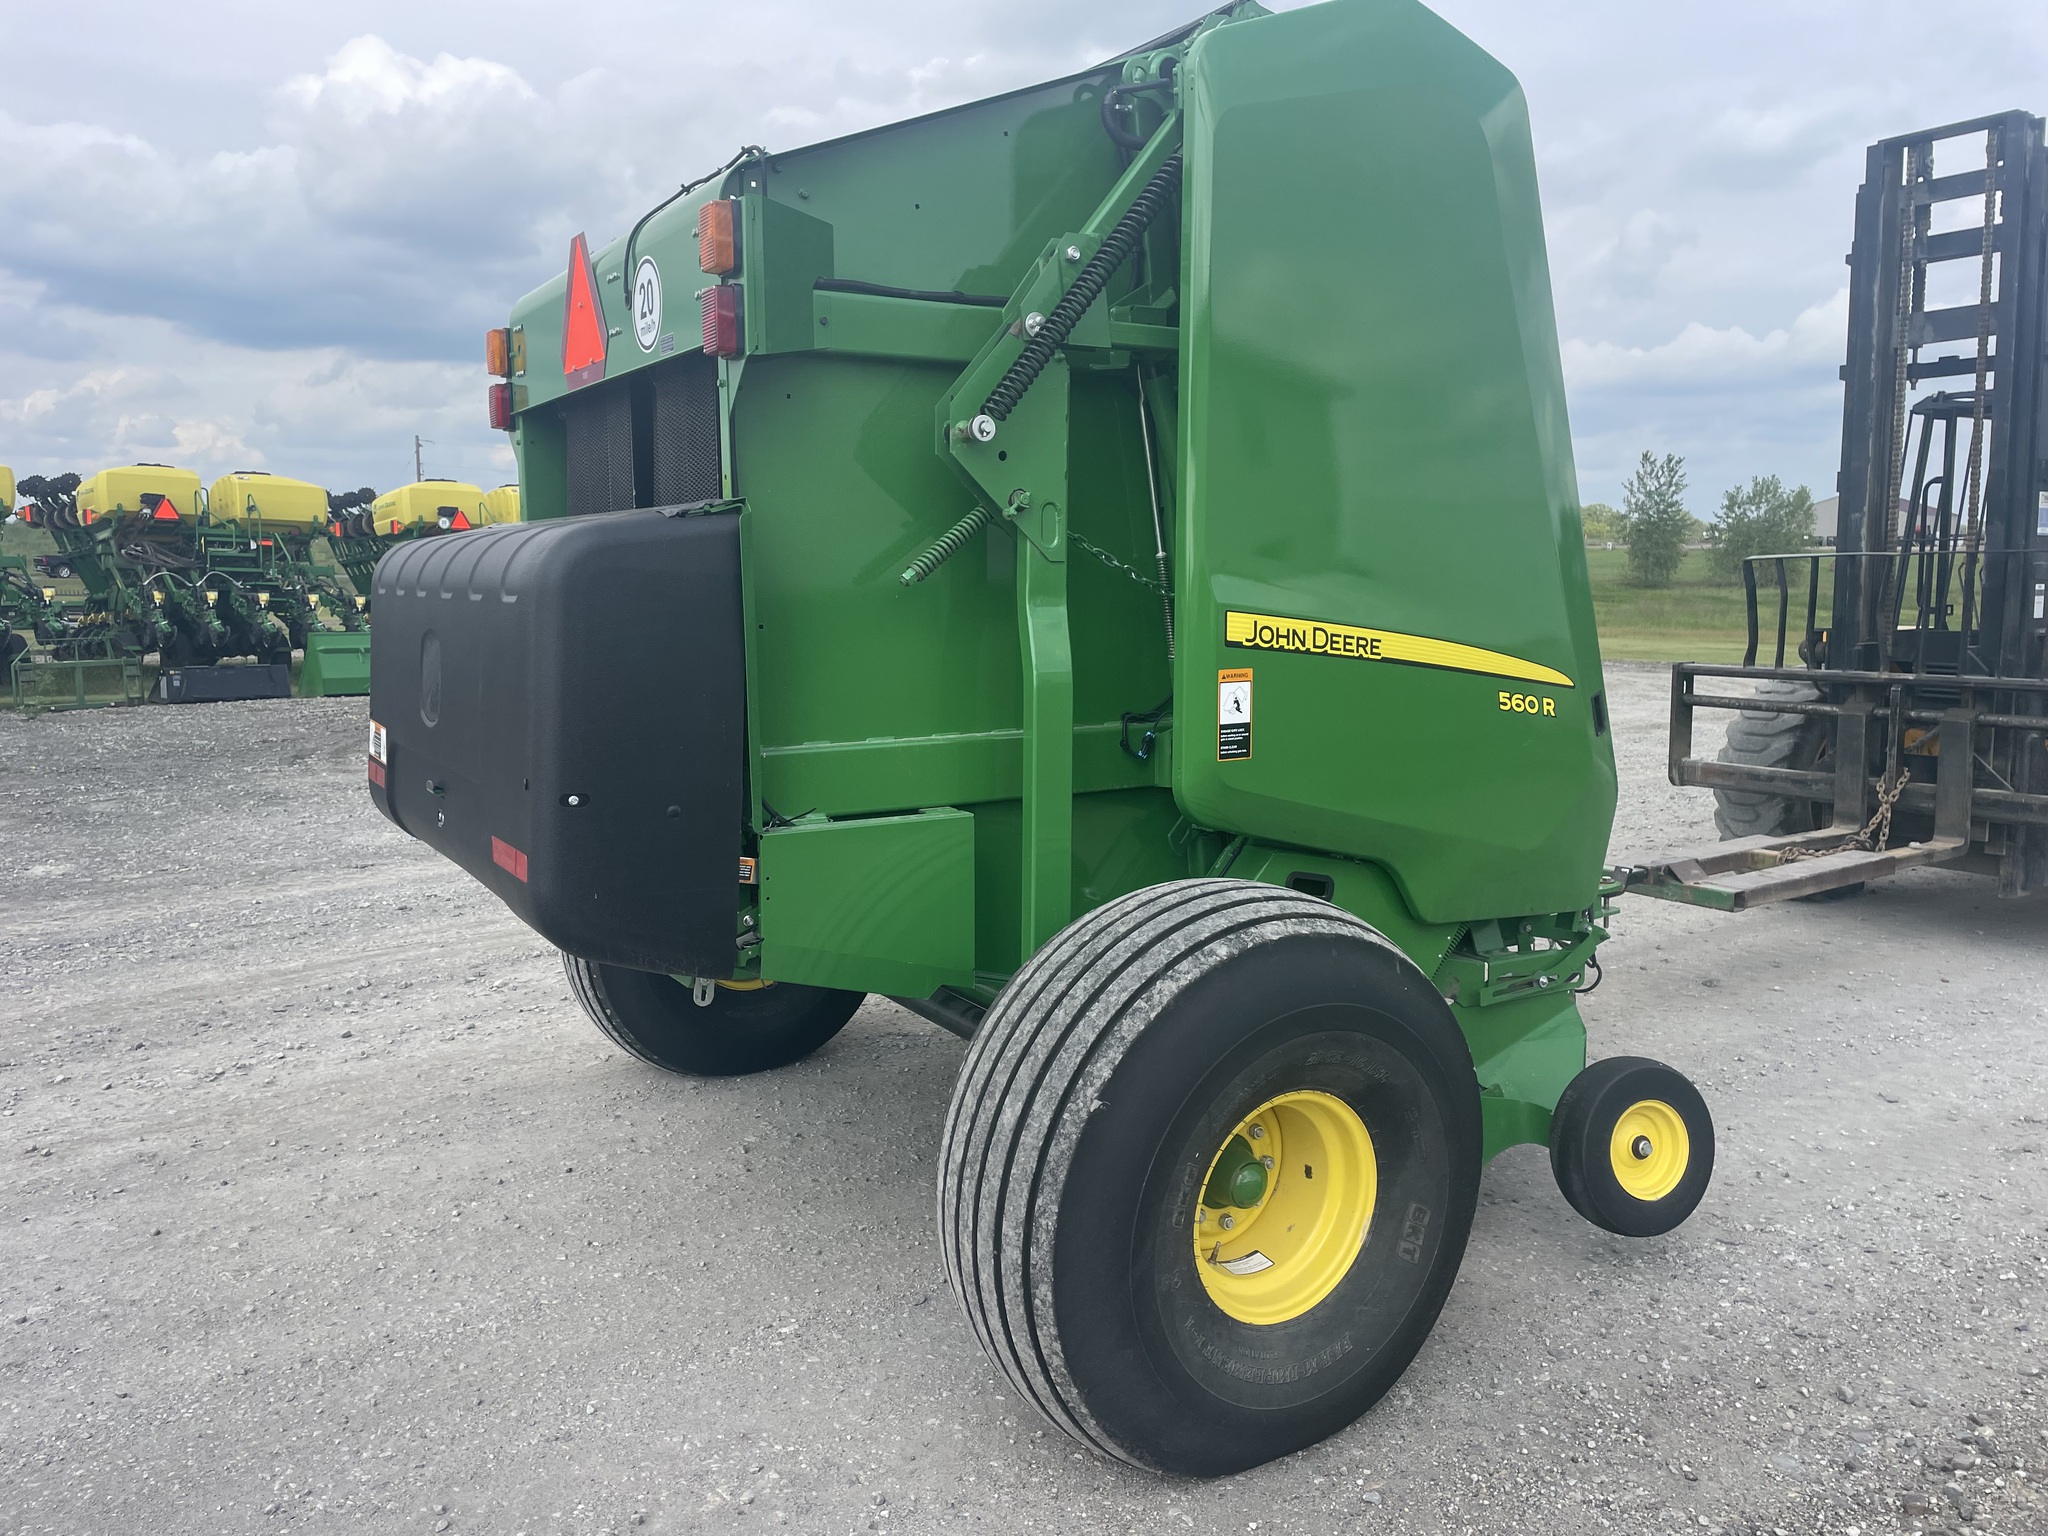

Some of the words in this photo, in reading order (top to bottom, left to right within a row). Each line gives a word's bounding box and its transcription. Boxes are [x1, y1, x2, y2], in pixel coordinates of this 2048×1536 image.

[639, 279, 654, 320] 20
[1245, 620, 1306, 648] JOHN
[1313, 627, 1382, 656] DEERE
[1498, 690, 1539, 714] 560
[1542, 696, 1556, 717] R
[1396, 1201, 1431, 1264] BKT
